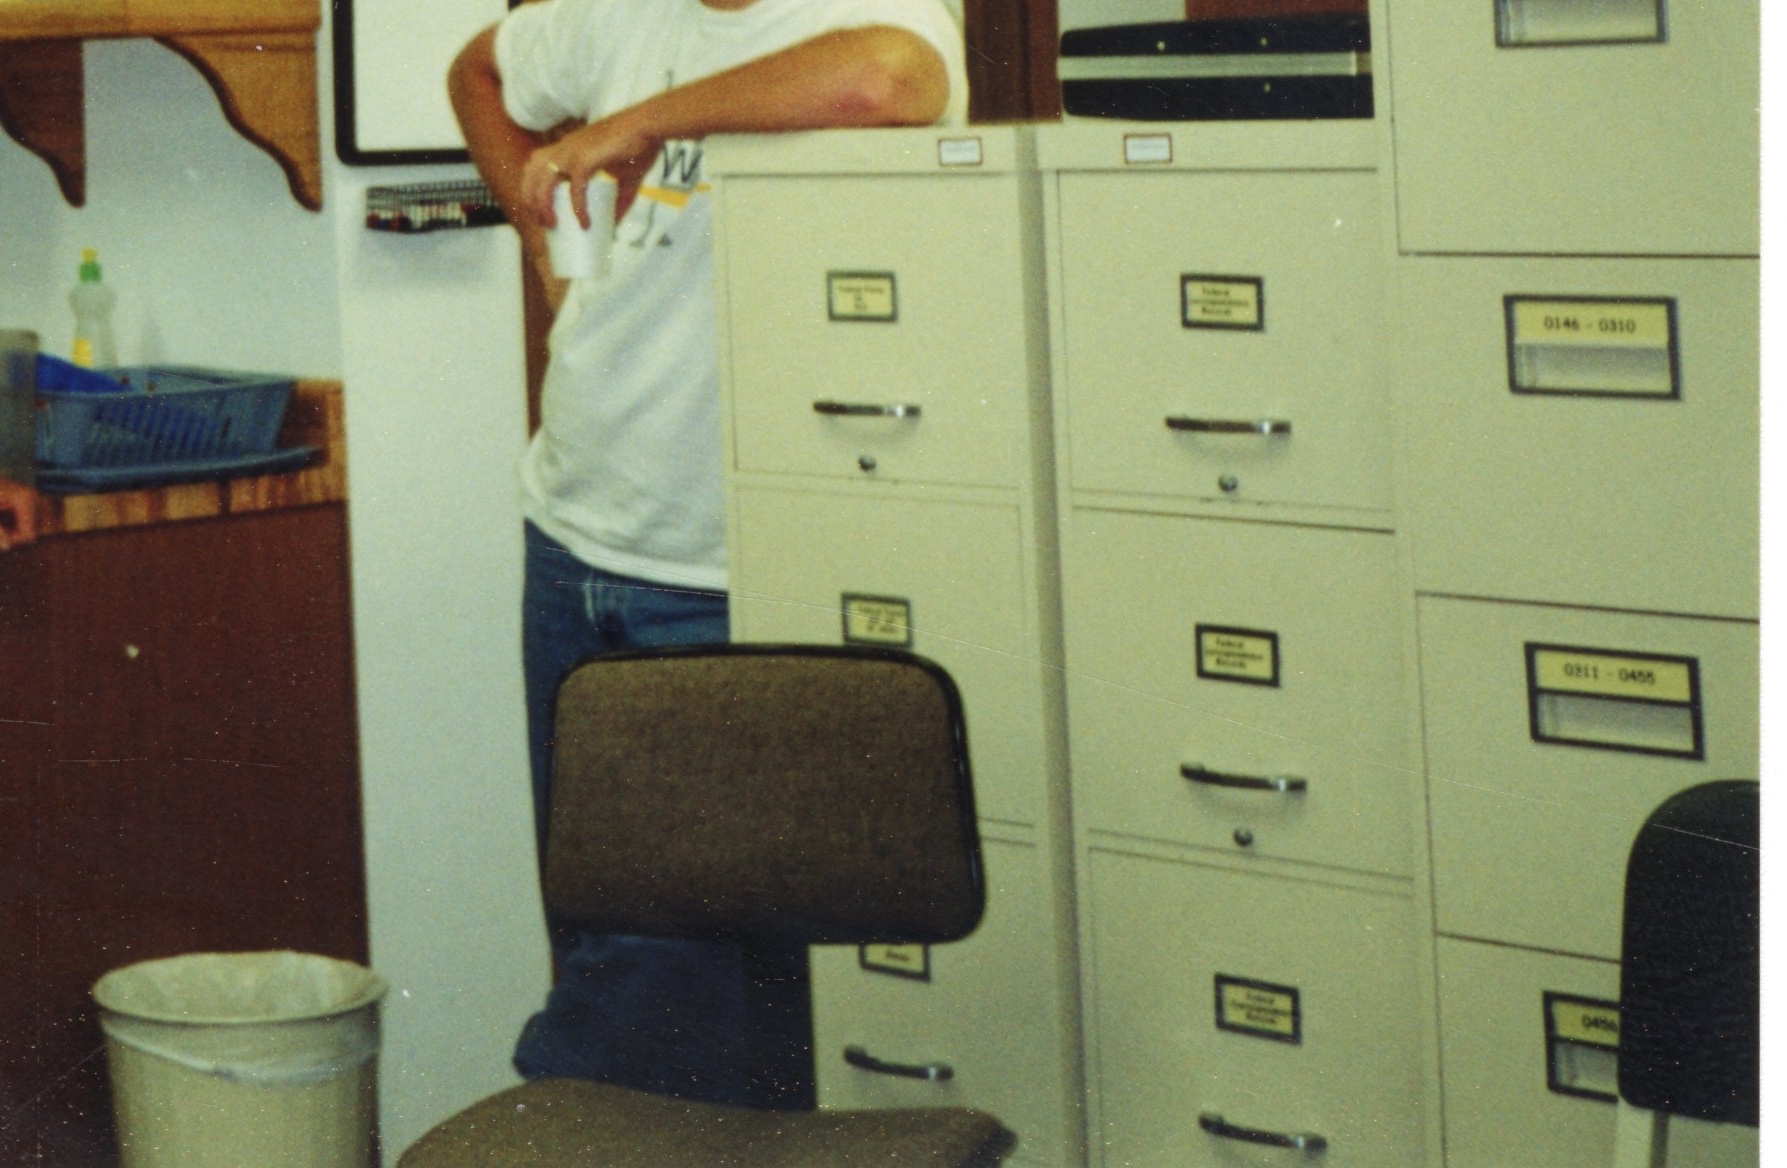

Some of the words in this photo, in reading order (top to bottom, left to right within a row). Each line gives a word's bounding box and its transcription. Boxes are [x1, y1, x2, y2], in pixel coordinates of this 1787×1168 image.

[1544, 316, 1581, 331] 0146
[1598, 318, 1637, 334] 0310
[1564, 662, 1600, 681] 0311
[1618, 668, 1657, 686] 0455
